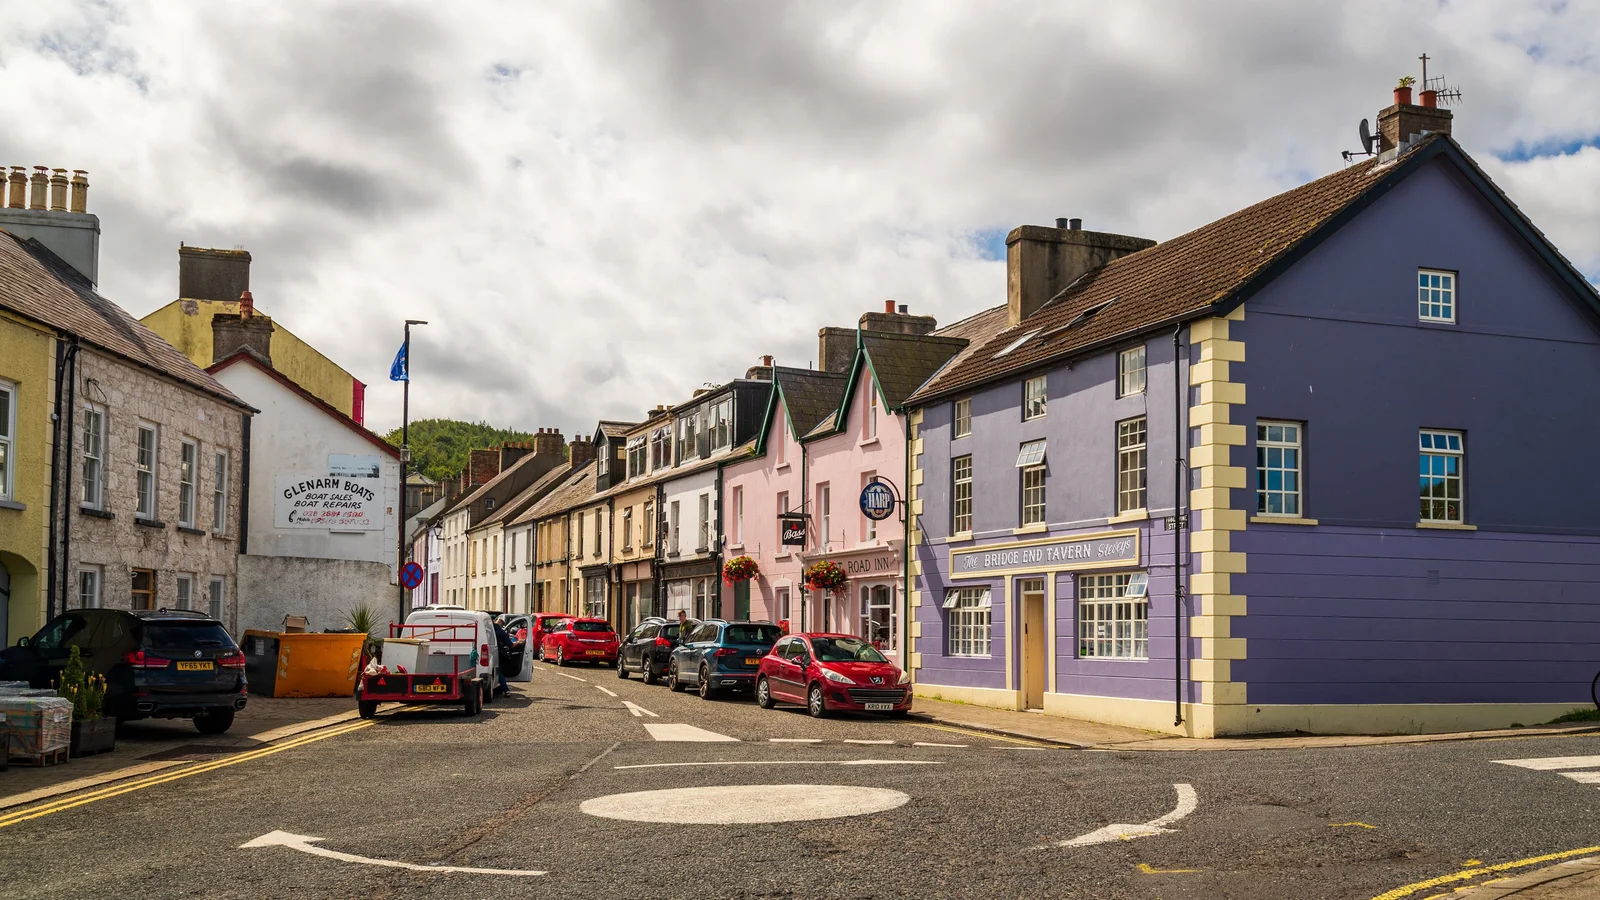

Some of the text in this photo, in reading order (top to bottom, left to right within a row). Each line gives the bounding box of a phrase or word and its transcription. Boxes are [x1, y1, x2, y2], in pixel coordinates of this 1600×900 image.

[284, 479, 374, 501] GLENARM BOATS
[330, 493, 353, 501] SALES
[323, 501, 362, 509] REPAIRS
[868, 492, 889, 508] HARP
[783, 528, 806, 540] Bass
[848, 560, 870, 573] ROAD
[875, 557, 889, 571] INN
[962, 555, 978, 570] The
[984, 552, 1018, 567] BRIDGE
[1022, 549, 1042, 563] END
[1047, 544, 1091, 561] TAVERN
